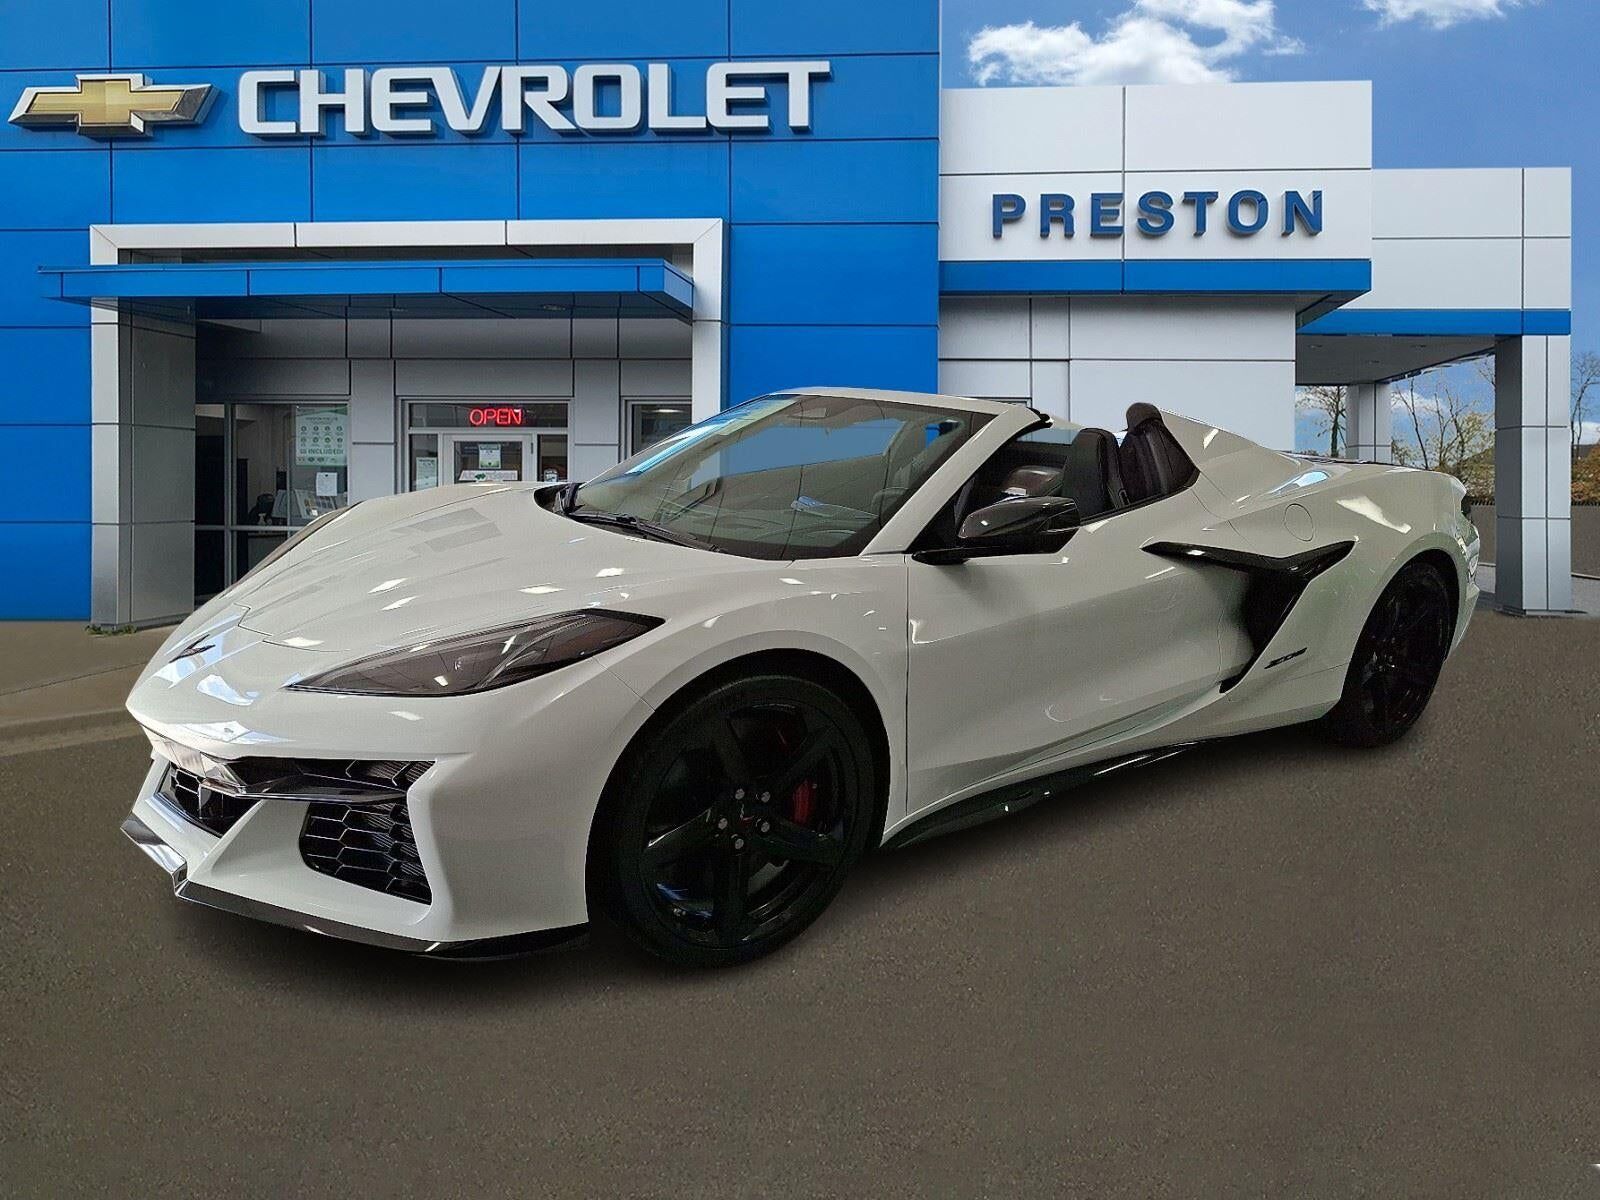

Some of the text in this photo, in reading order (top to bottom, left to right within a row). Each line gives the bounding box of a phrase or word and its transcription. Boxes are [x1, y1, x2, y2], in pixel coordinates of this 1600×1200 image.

[238, 60, 831, 136] CHEVROLET
[992, 189, 1323, 239] PRESTON
[468, 408, 523, 426] OPEN
